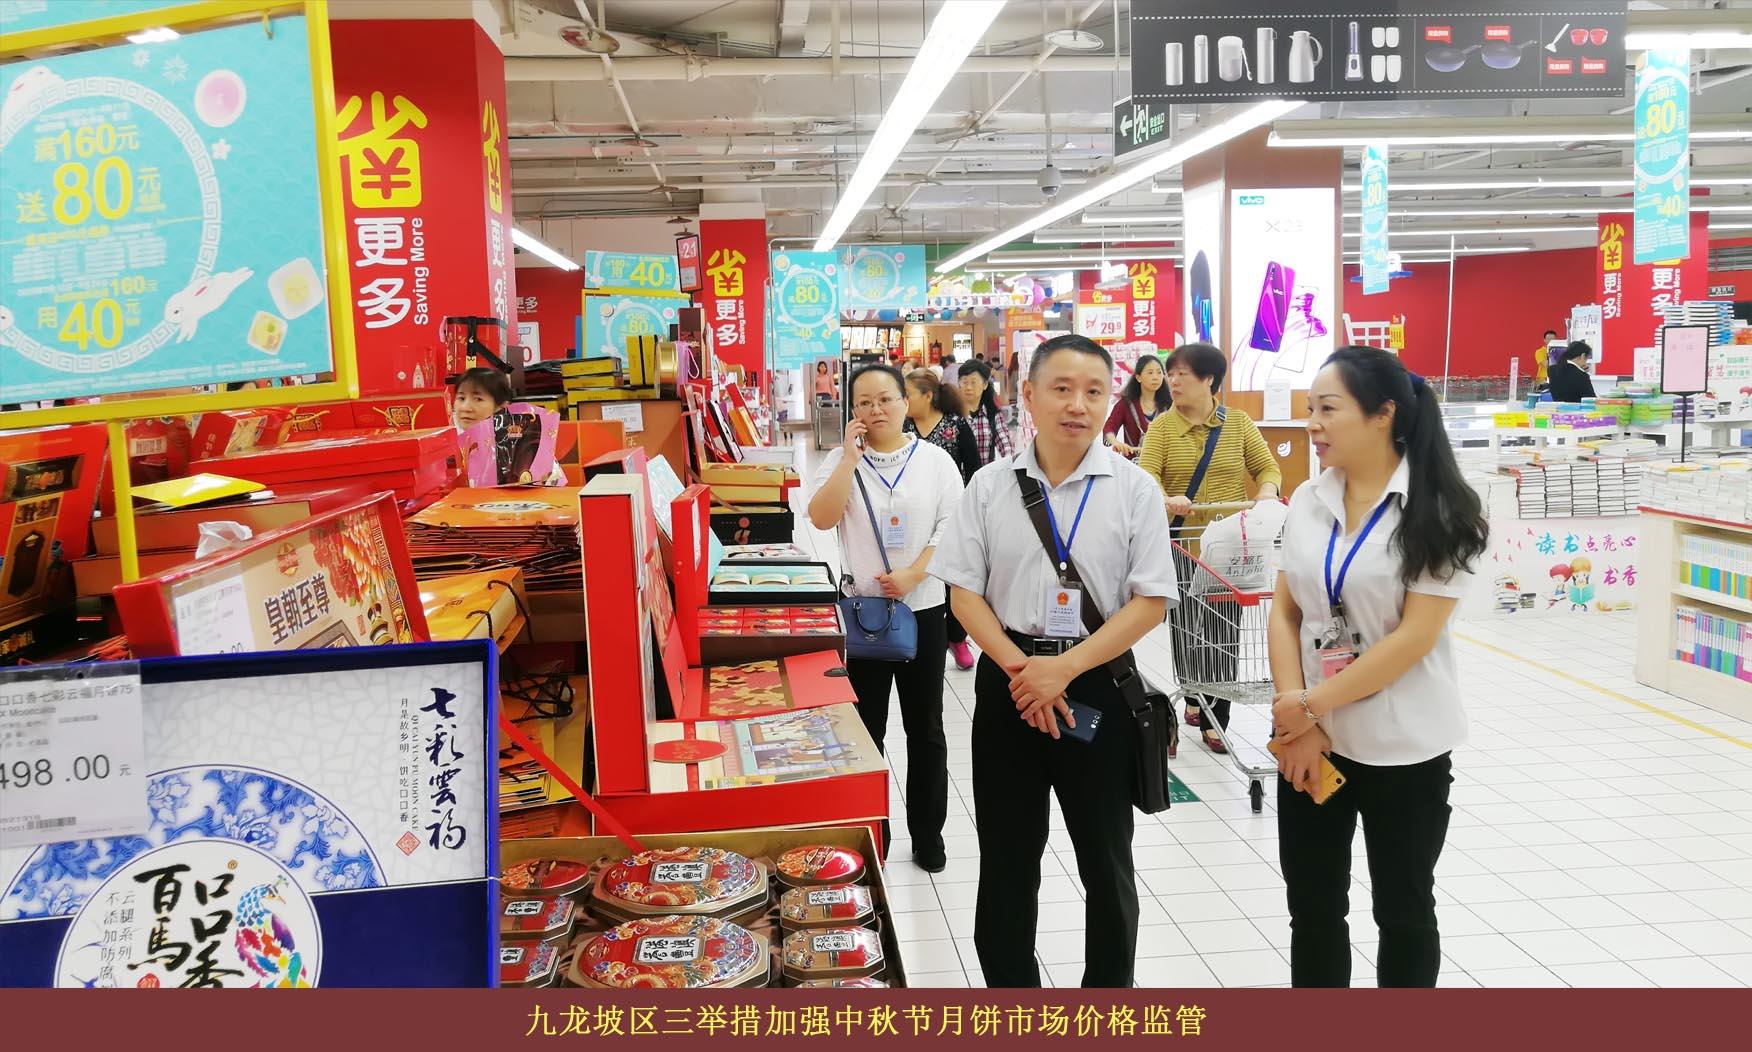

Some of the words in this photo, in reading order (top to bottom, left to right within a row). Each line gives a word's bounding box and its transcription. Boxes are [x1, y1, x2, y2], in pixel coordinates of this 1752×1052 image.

[410, 217, 424, 262] More
[413, 267, 430, 325] Saving
[1603, 564, 1638, 586] 书香
[264, 573, 332, 645] 皇朝至尊
[119, 763, 132, 776] 元
